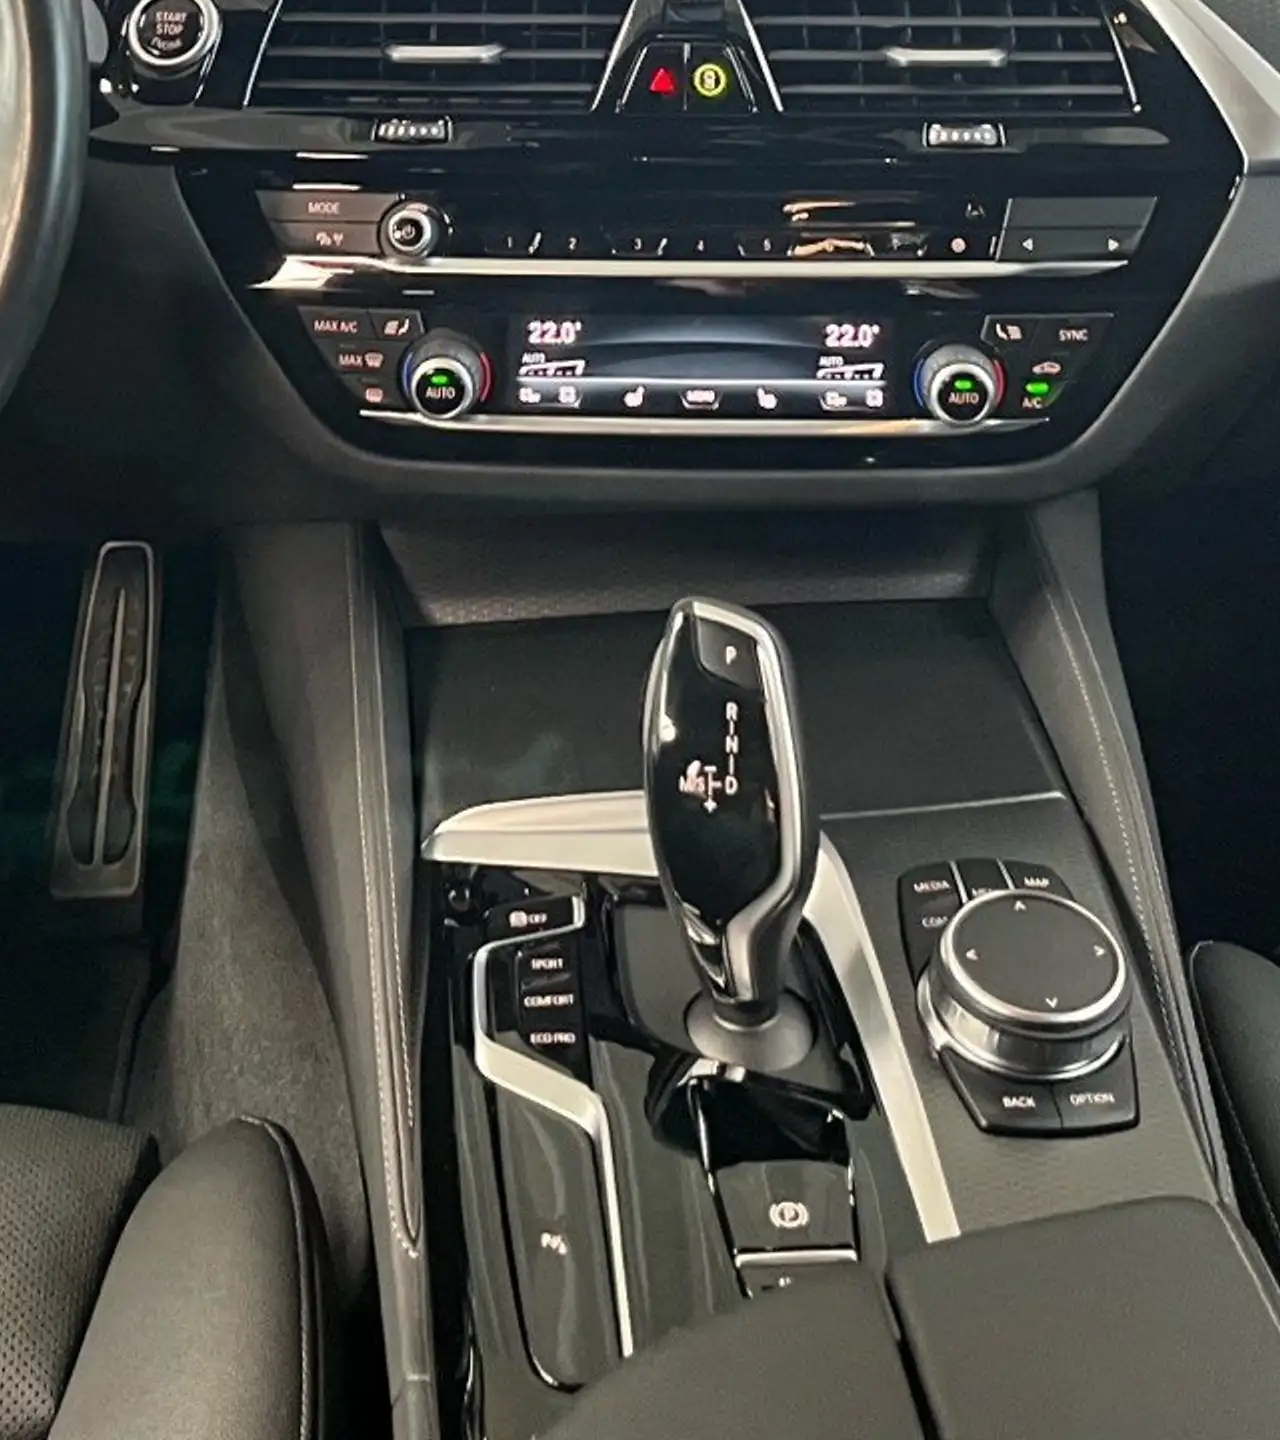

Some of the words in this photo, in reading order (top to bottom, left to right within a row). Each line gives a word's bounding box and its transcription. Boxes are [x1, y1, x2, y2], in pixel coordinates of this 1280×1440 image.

[155, 11, 188, 22] START
[155, 23, 184, 36] STOP
[307, 201, 340, 215] MODE
[313, 320, 339, 333] MAX
[339, 320, 358, 334] A/C
[824, 323, 881, 348] 22.0°
[1058, 328, 1089, 342] SYNC
[338, 353, 362, 367] MAX
[522, 352, 546, 364] AUTO
[425, 387, 456, 400] AUTO
[948, 392, 980, 405] AUTO
[1022, 396, 1043, 409] A/C
[726, 646, 738, 665] P
[726, 702, 738, 721] R
[725, 735, 739, 754] N
[725, 775, 738, 795] D
[913, 879, 951, 893] MEDIA
[1023, 876, 1050, 889] MAP
[531, 957, 564, 970] SPORT
[524, 993, 574, 1008] COMFORT
[529, 1031, 553, 1045] ECO
[1002, 1095, 1037, 1109] BACK
[1069, 1091, 1116, 1108] OPTION
